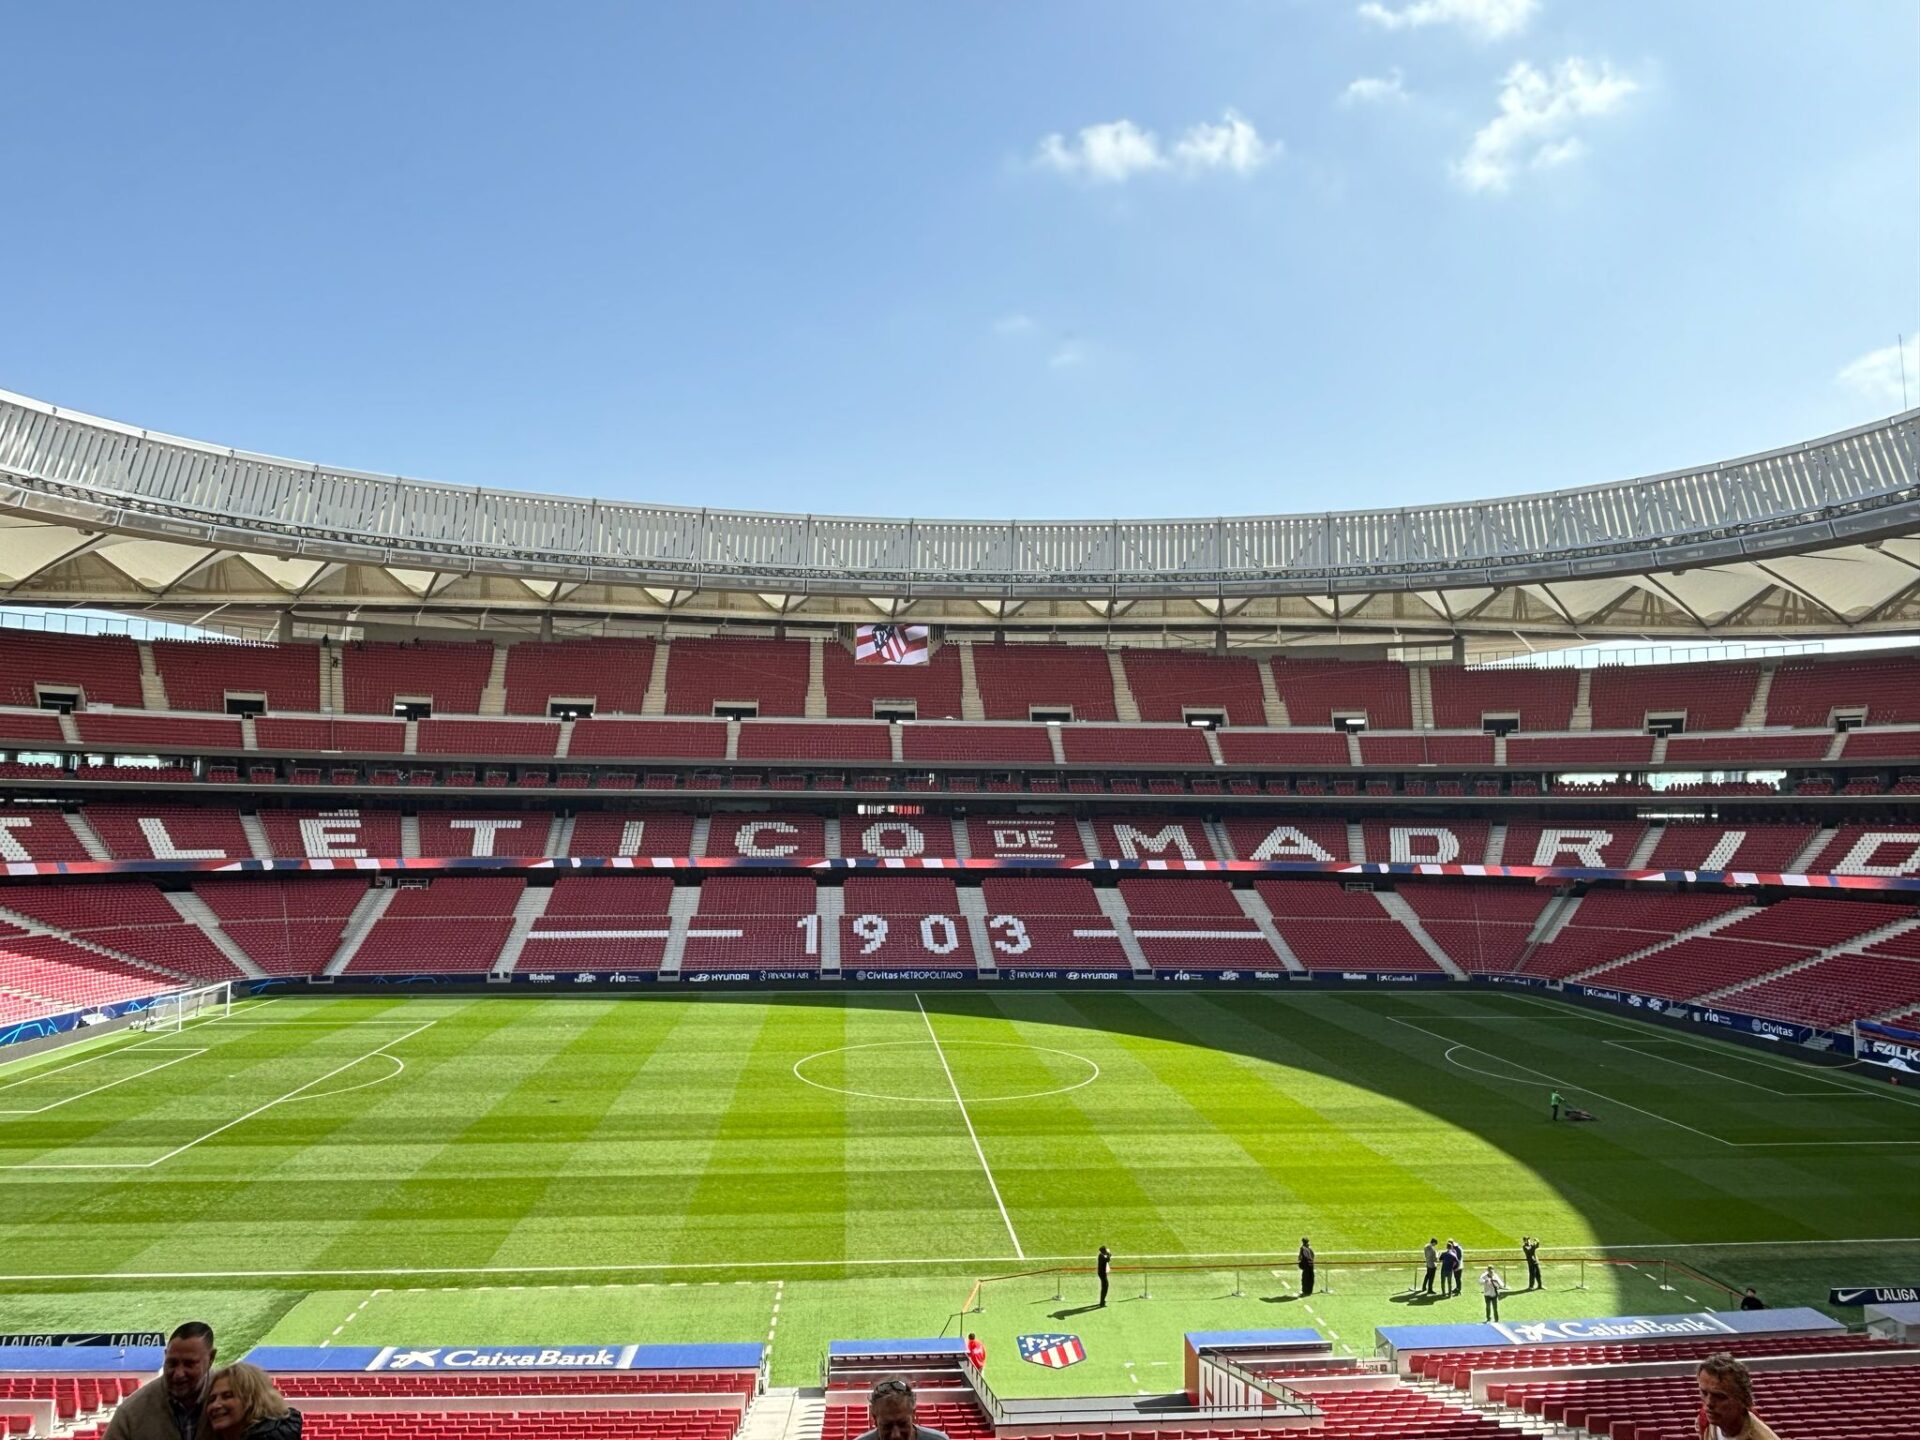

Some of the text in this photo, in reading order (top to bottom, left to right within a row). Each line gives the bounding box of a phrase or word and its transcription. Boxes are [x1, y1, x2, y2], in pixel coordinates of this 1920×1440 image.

[995, 829, 1058, 848] DE
[1113, 824, 1920, 876] MADRID
[797, 914, 1031, 954] 1903
[900, 971, 963, 980] METROPOLITANO
[1875, 1288, 1918, 1301] LALIGA
[1558, 1317, 1716, 1337] CaixaBank
[2, 1335, 52, 1346] LALIGA
[110, 1334, 161, 1346] LALIGA
[443, 1349, 615, 1367] CaixaBank
